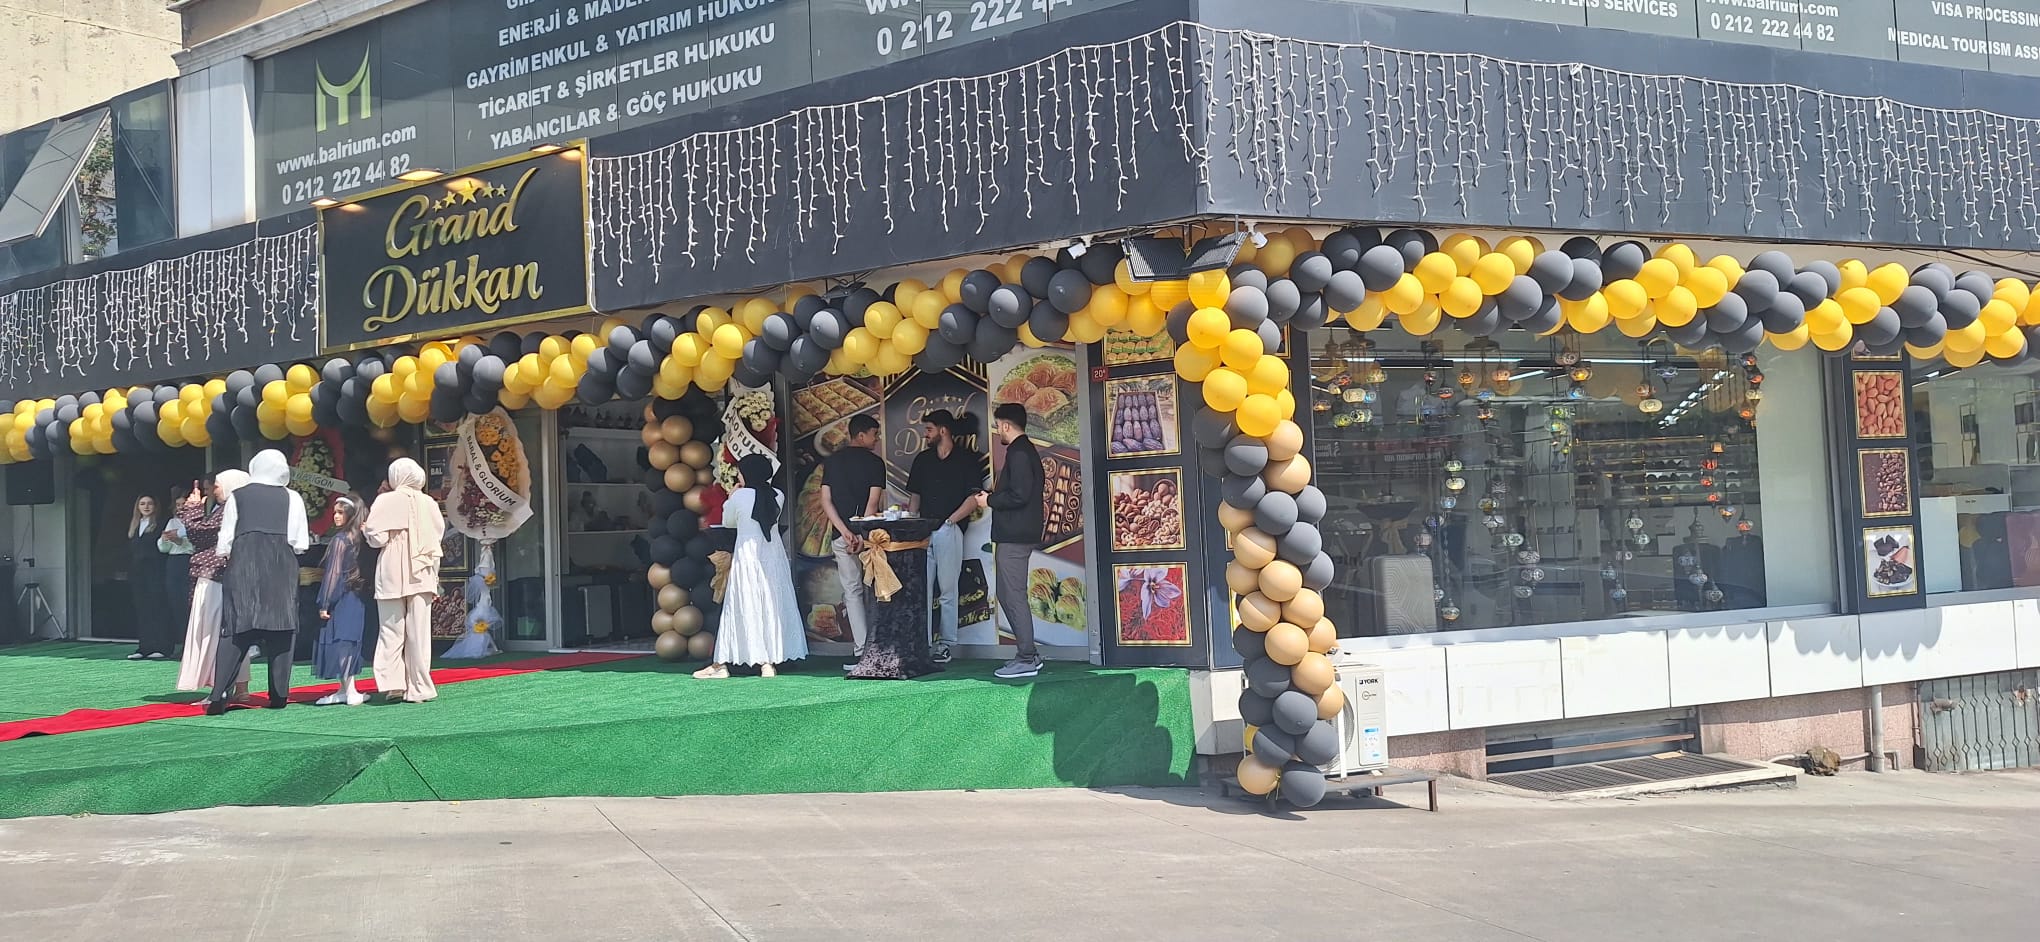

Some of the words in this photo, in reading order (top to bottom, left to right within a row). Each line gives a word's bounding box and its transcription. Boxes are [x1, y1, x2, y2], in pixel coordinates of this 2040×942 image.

[499, 9, 561, 47] ENERJİ
[567, 8, 580, 26] &
[877, 27, 893, 55] 0
[901, 10, 954, 50] 212
[970, 0, 1023, 32] 222
[1604, 0, 1678, 18] SERVICES
[1707, 0, 1839, 17] ww.balrium.com
[1711, 12, 1721, 30] 0
[1725, 14, 1753, 34] 212
[1761, 18, 1789, 38] 222
[1793, 22, 1812, 39] 44
[1817, 24, 1835, 42] 82
[1932, 1, 1963, 18] VISA
[1966, 5, 2040, 27] PROCESSIN
[466, 37, 590, 89] GAYRİMENKUL
[596, 34, 609, 52] &
[616, 10, 692, 47] YATIRIM
[1887, 27, 1949, 50] MEDICAL
[1951, 37, 2011, 57] TOURISM
[2014, 44, 2040, 62] ASS
[479, 84, 551, 120] TİCARET
[557, 80, 569, 99] &
[575, 50, 679, 98] ŞİRKETLER
[684, 23, 775, 65] HUKUKU
[490, 103, 601, 150] YABANCILAR
[606, 103, 620, 122] &
[627, 90, 666, 117] GÖÇ
[672, 66, 762, 106] HUKUKU
[277, 125, 417, 175] www.balrium.com
[282, 183, 290, 205] 0
[295, 176, 324, 201] 212
[333, 165, 361, 193] 222
[365, 160, 386, 184] 44
[390, 153, 410, 178] 82
[385, 167, 538, 259] Grand
[362, 254, 544, 332] Dükkan
[479, 471, 516, 506] GLORİUM
